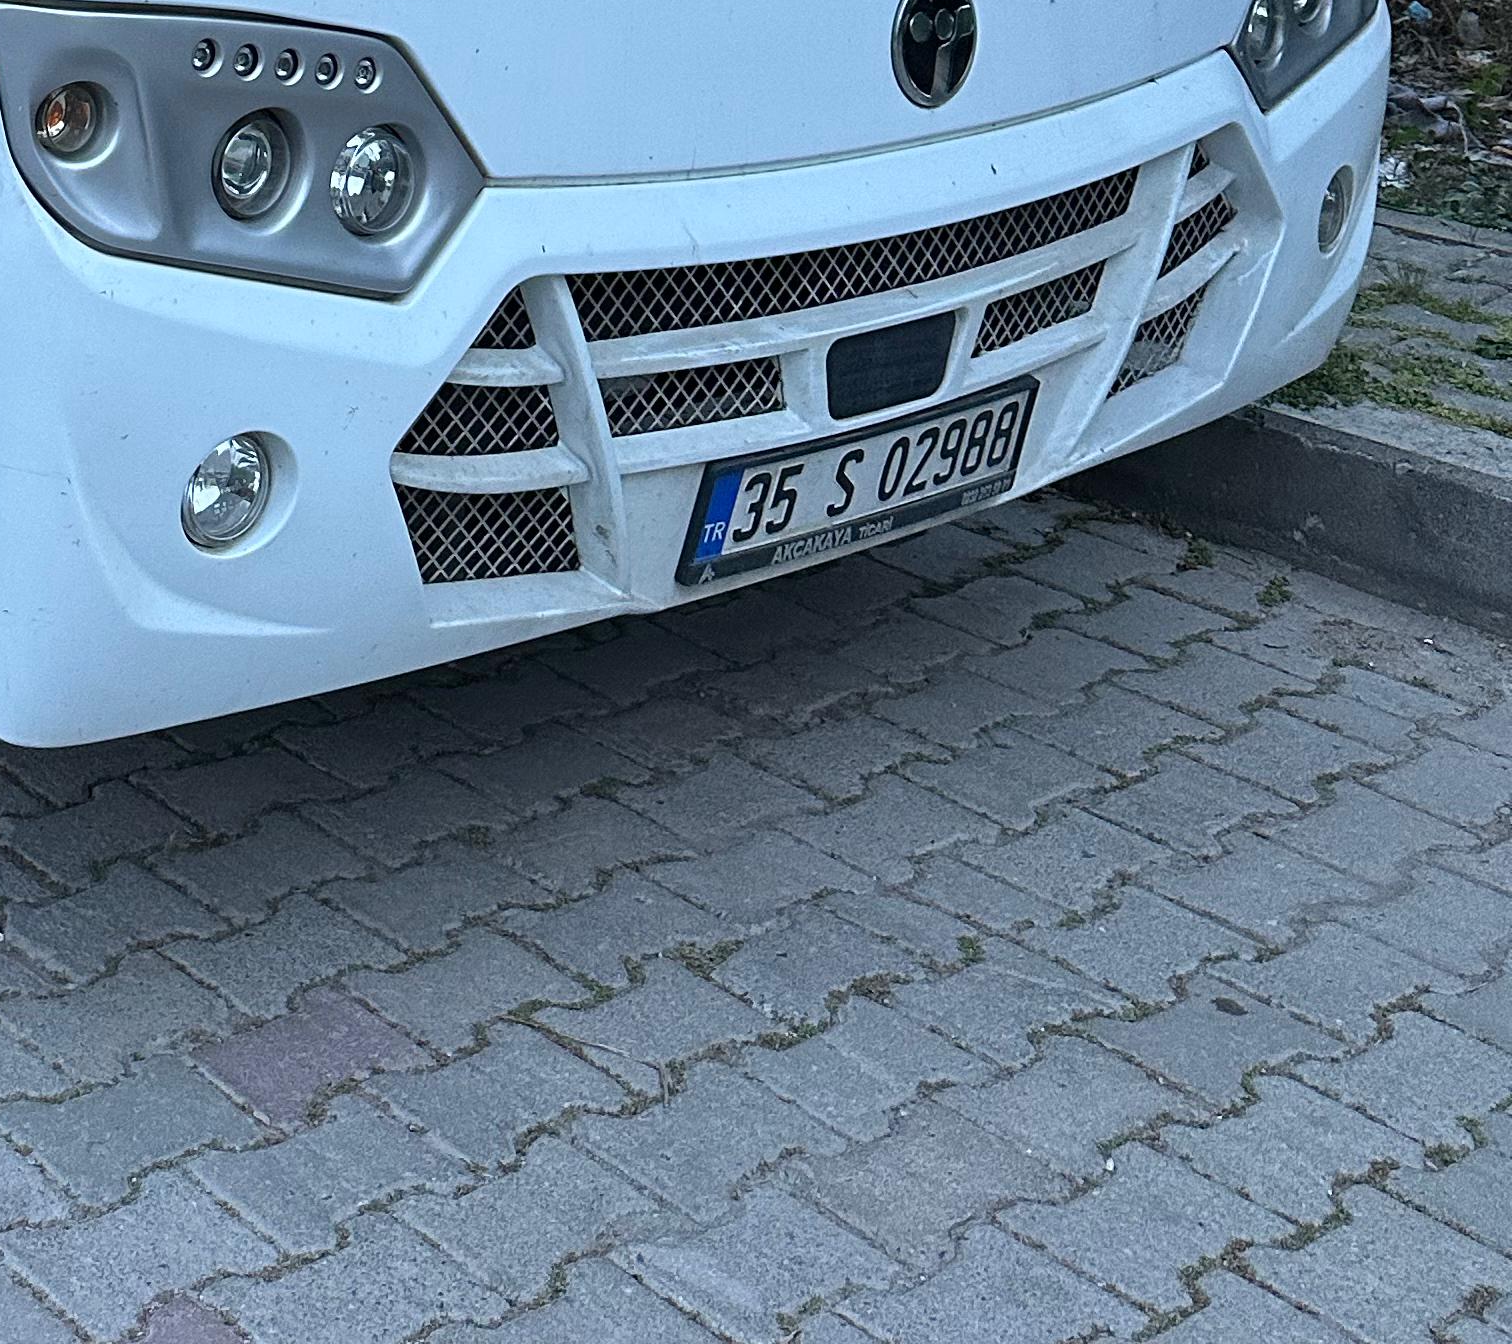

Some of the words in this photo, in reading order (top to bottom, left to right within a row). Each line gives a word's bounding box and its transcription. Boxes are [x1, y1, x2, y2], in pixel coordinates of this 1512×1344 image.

[703, 521, 727, 543] TR
[732, 463, 805, 543] 35
[826, 448, 865, 518] S
[877, 400, 1020, 502] 02988
